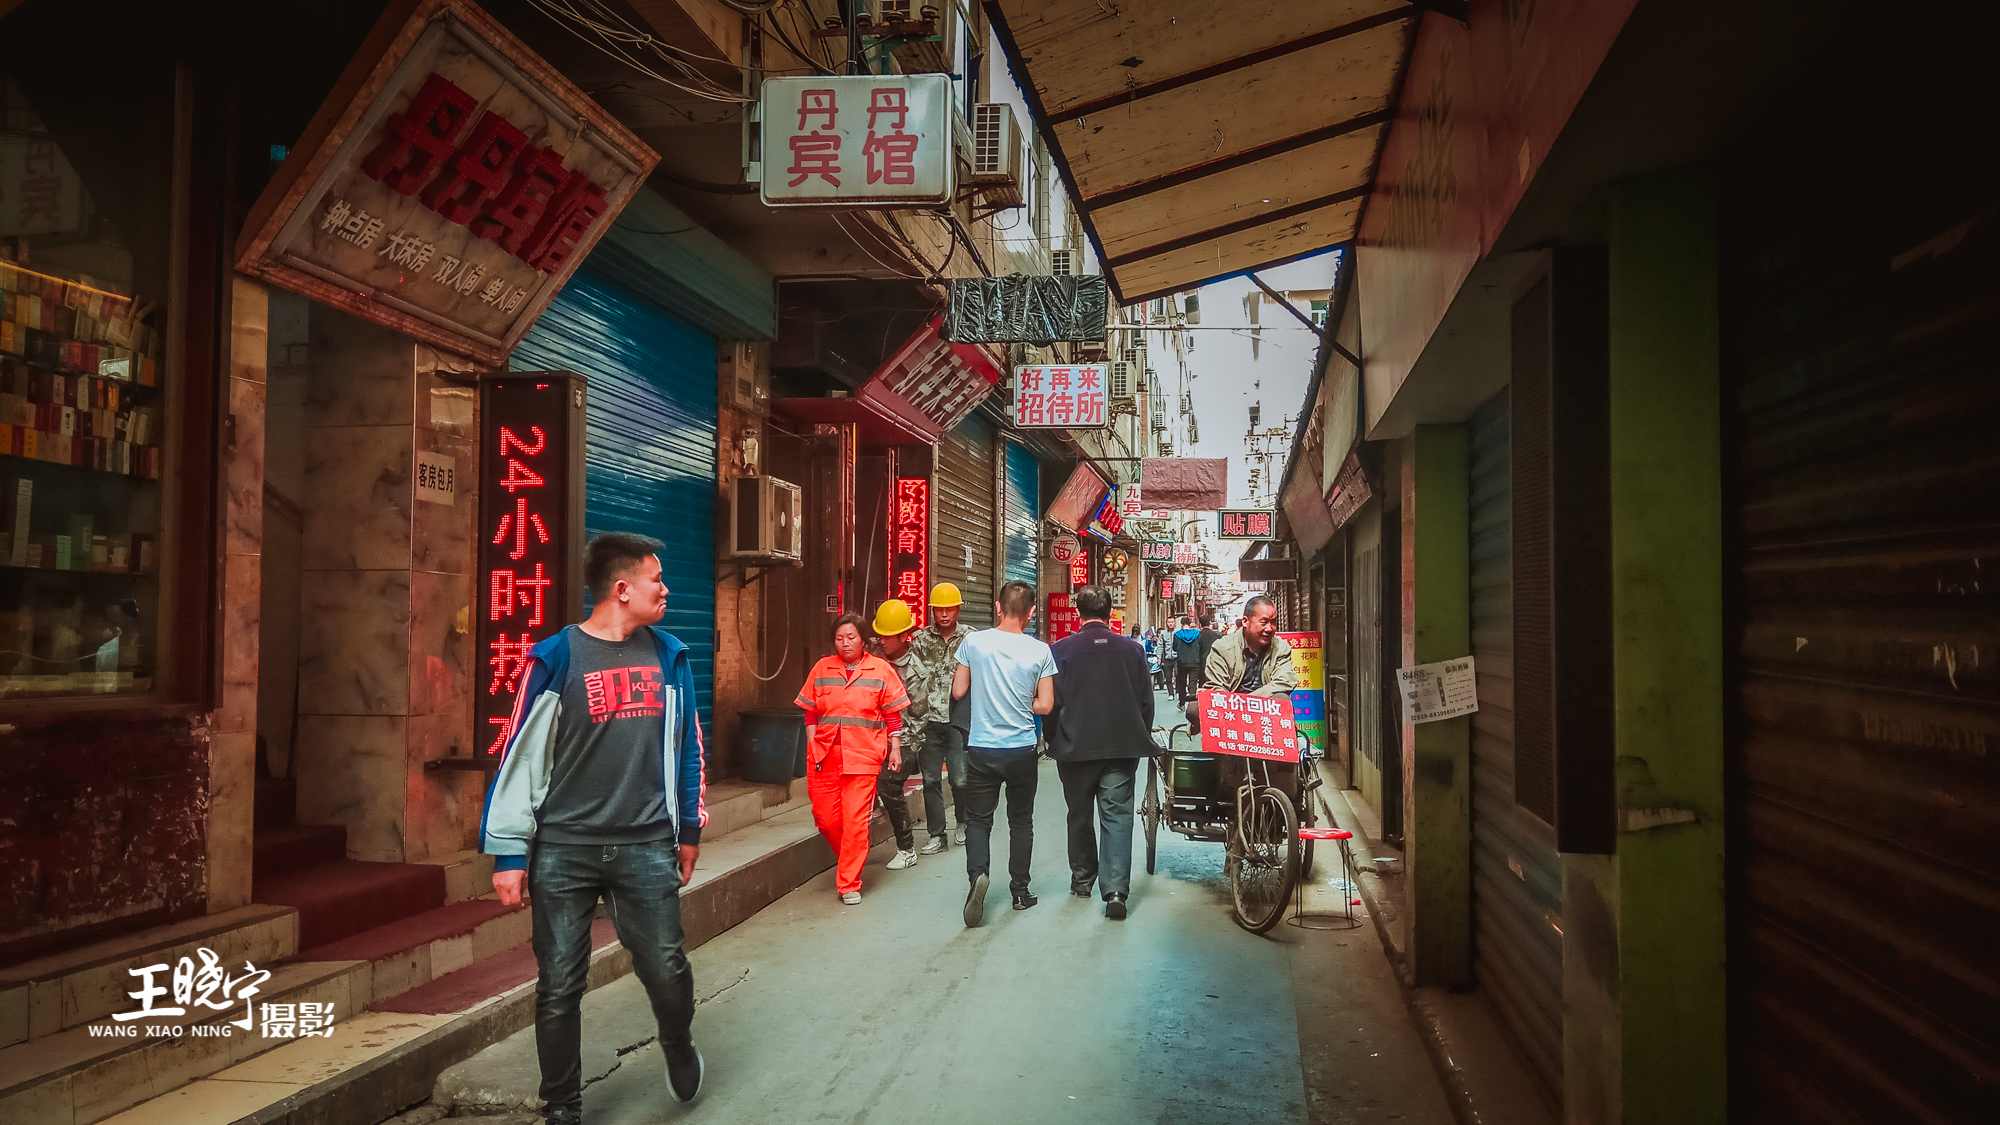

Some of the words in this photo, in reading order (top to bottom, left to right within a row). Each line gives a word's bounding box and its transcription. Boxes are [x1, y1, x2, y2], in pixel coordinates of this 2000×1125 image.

[797, 87, 909, 131] 丹丹
[787, 129, 918, 188] 宾馆
[360, 73, 609, 277] 丹丹宾馆
[321, 200, 385, 249] 钟点房
[379, 230, 436, 273] 大床房
[432, 255, 486, 297] 双人间
[479, 278, 527, 314] 单人间
[1020, 368, 1100, 391] 好再来
[1017, 391, 1103, 424] 招待所
[418, 462, 454, 493] 客房包月
[1223, 513, 1271, 536] 贴膜
[1142, 543, 1172, 560] 盲人推拿
[583, 671, 607, 716] ROCCO
[1211, 692, 1282, 717] 高价回收
[1207, 709, 1221, 738] 空调
[1225, 711, 1238, 740] 冰箱
[1242, 713, 1256, 743] 电脑
[1260, 716, 1274, 746] 洗衣机
[1218, 741, 1236, 751] 电话
